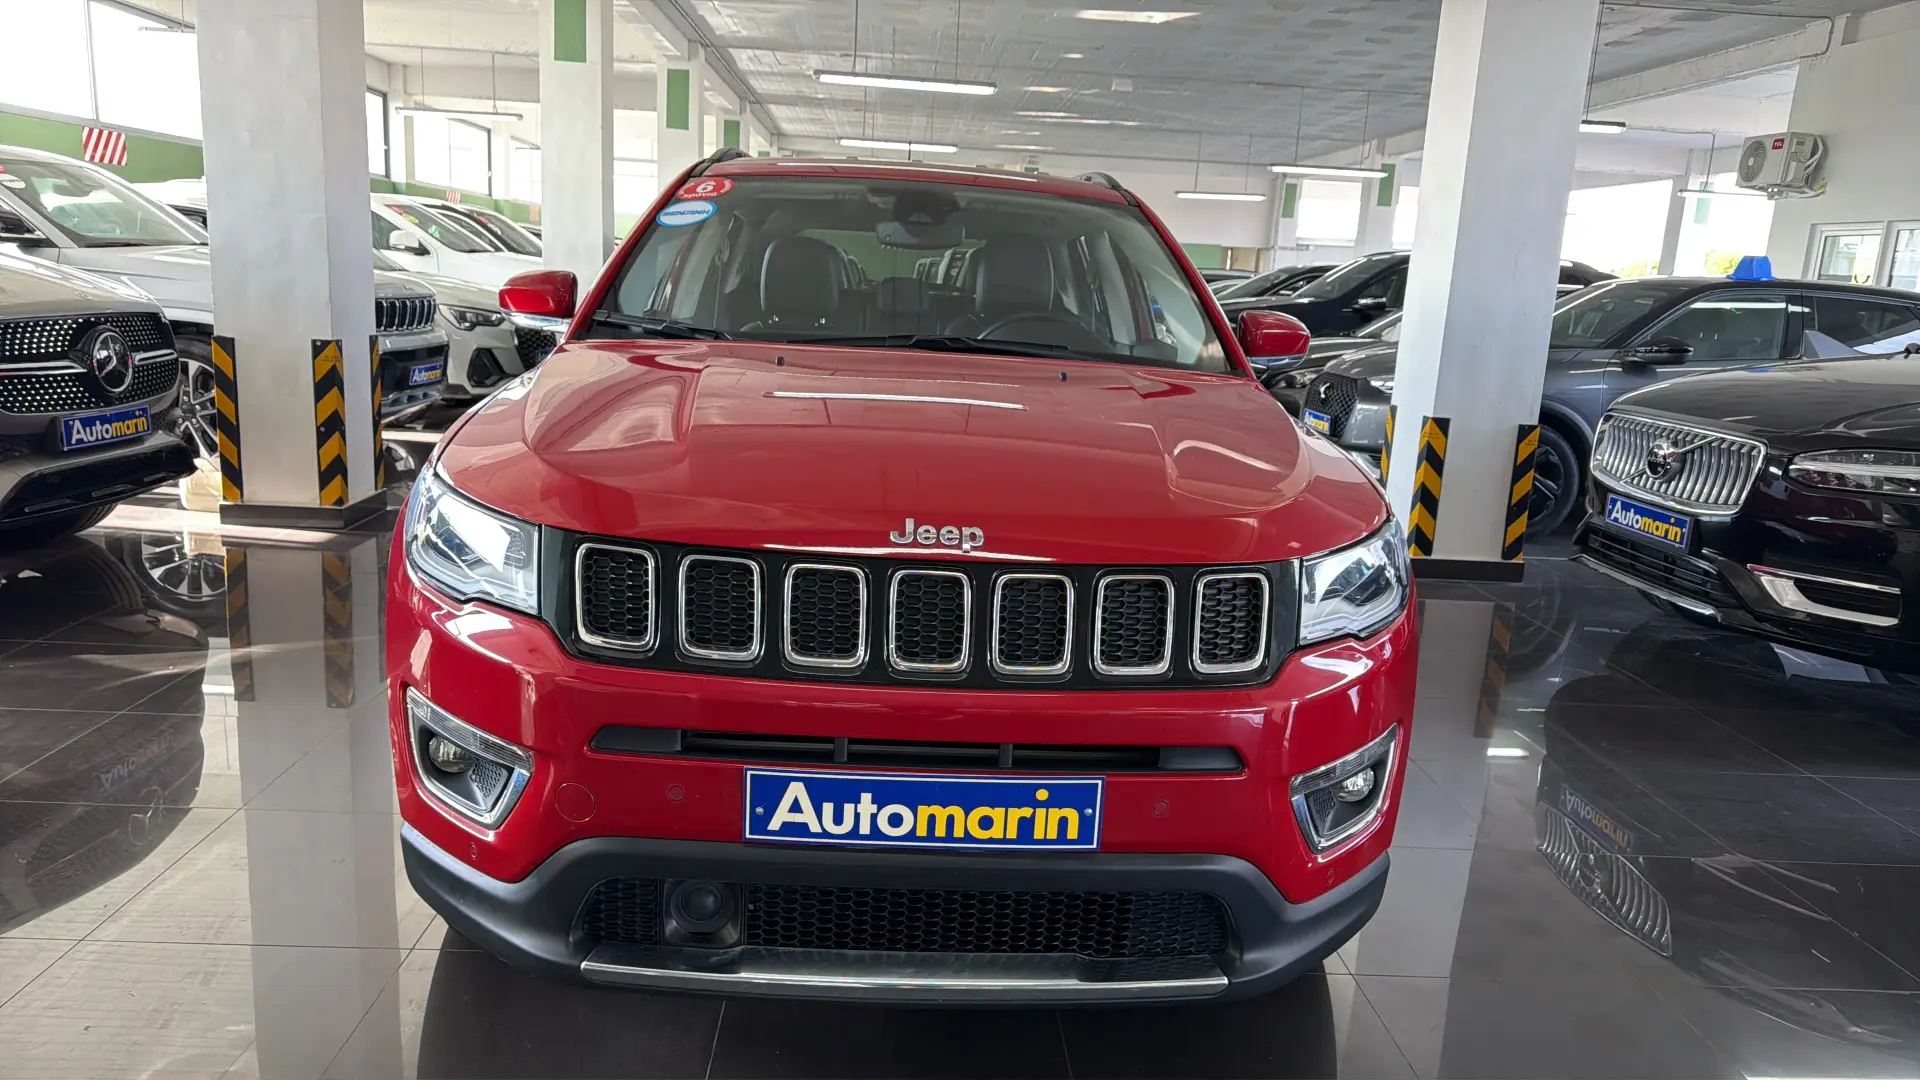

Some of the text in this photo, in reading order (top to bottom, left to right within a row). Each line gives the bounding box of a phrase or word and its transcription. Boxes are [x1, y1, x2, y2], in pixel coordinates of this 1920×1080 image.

[696, 180, 716, 193] 6
[71, 410, 148, 445] Automarin
[890, 518, 984, 553] Jeep
[1611, 500, 1682, 543] Automarin
[767, 781, 1080, 840] Automarin
